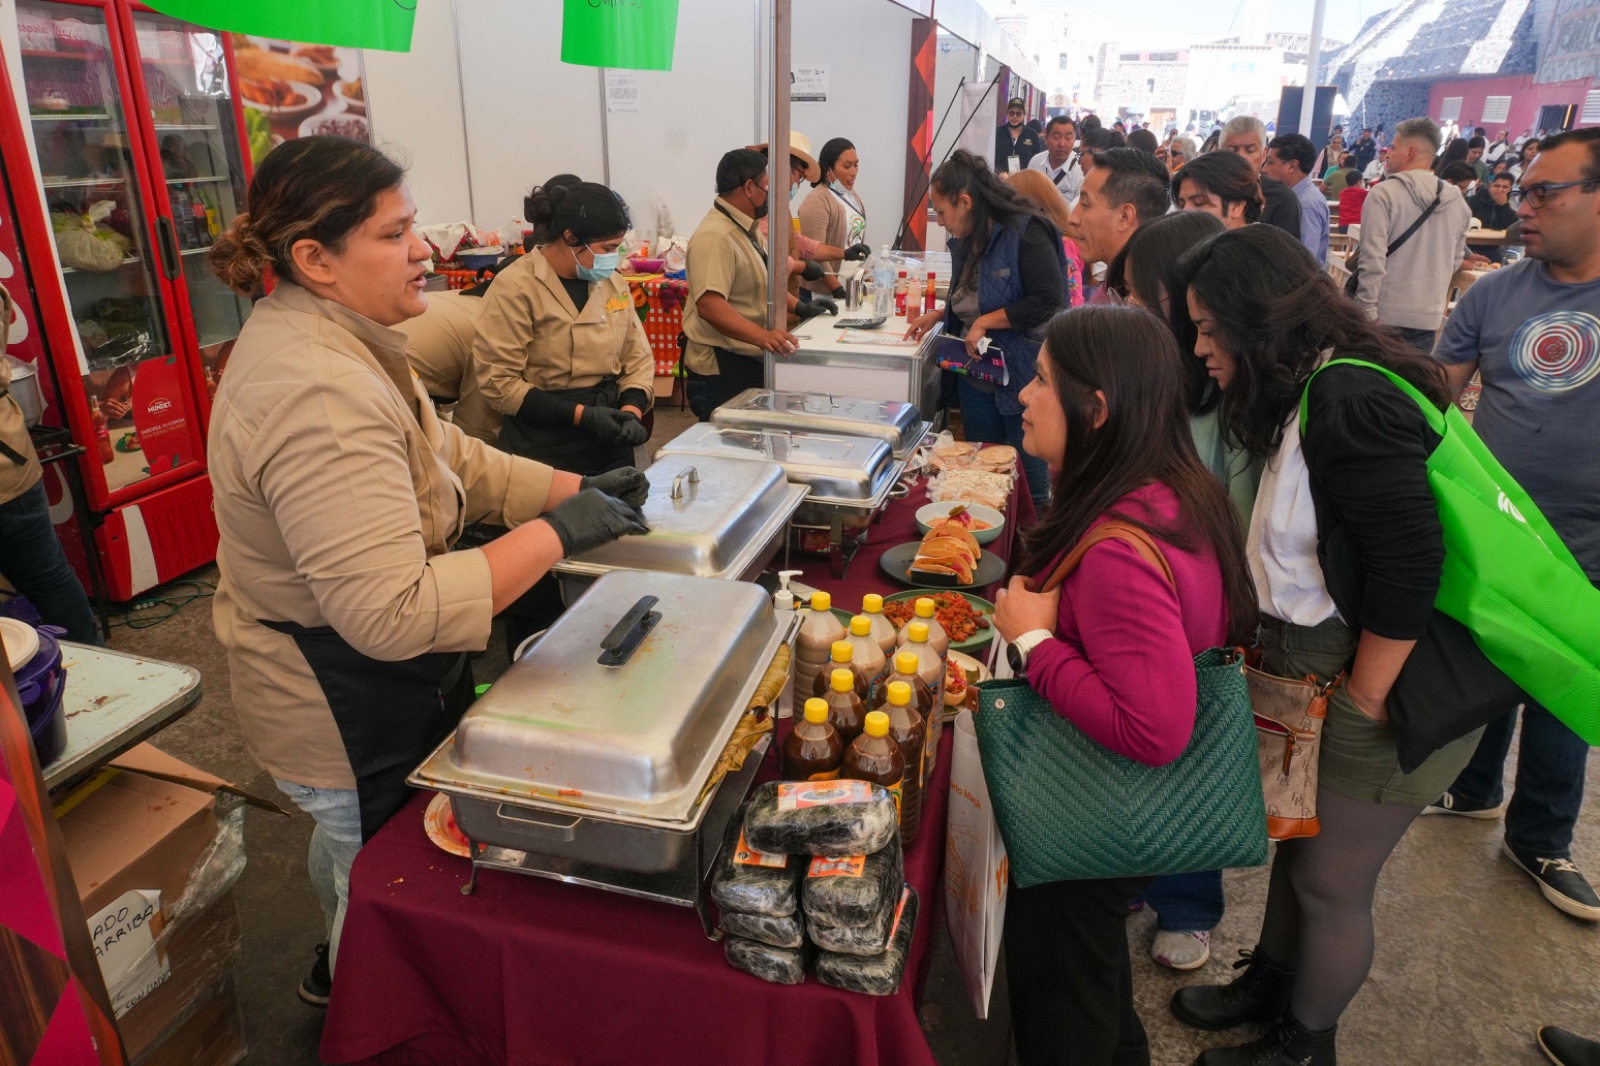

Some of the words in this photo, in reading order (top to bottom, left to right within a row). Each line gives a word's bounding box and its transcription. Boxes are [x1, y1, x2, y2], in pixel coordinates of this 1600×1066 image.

[148, 401, 171, 413] MUNDET
[92, 907, 129, 941] ADO
[95, 904, 154, 957] ARRIBA
